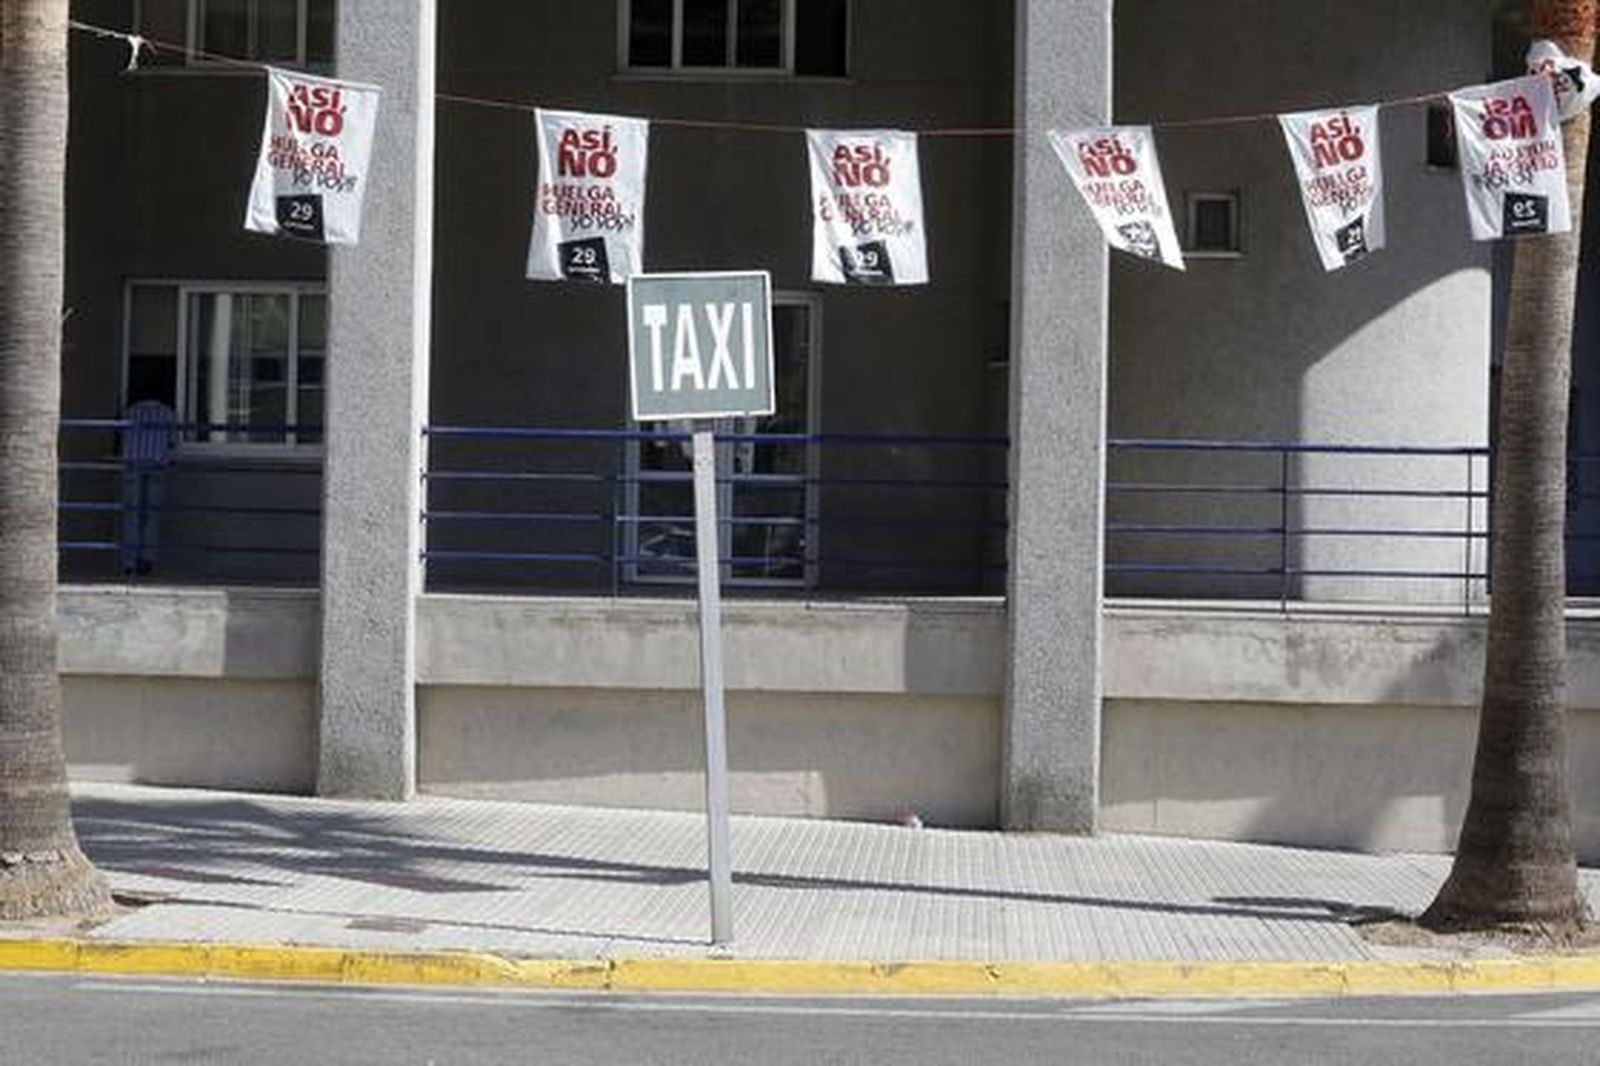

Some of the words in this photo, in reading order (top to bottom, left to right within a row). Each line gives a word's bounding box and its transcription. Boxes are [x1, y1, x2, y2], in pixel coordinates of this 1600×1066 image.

[285, 105, 344, 137] NO
[557, 148, 618, 178] NO
[1082, 154, 1138, 178] NO
[1312, 135, 1366, 169] NO
[832, 161, 890, 188] NO
[289, 201, 314, 221] 29
[571, 247, 596, 264] 29
[642, 302, 756, 392] TAXI
